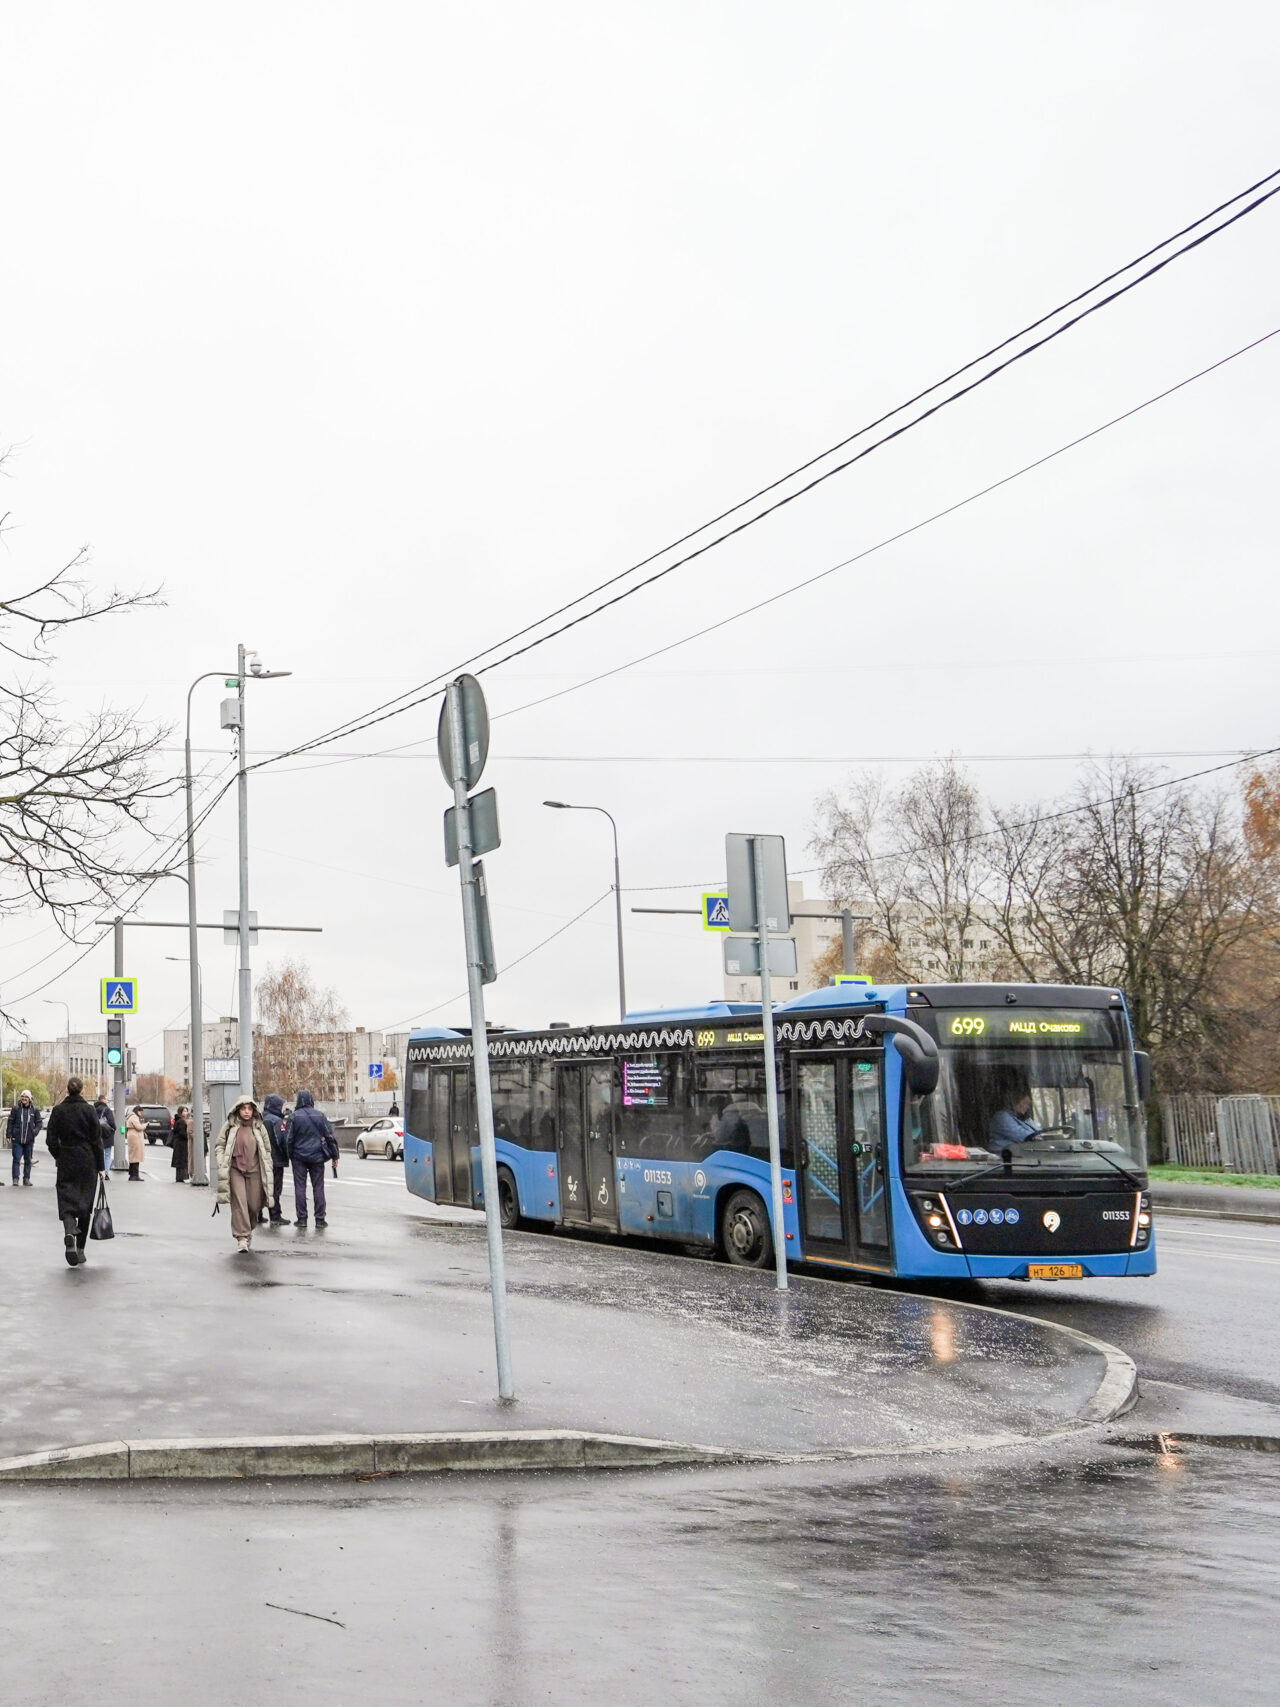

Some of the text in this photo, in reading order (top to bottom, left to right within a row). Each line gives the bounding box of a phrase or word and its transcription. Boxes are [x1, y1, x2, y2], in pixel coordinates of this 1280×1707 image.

[951, 1017, 1081, 1035] 699 МЦД Очаково
[697, 1031, 715, 1046] 699
[644, 1168, 672, 1185] 011353
[1102, 1211, 1130, 1221] 011353
[1049, 1266, 1066, 1276] 126
